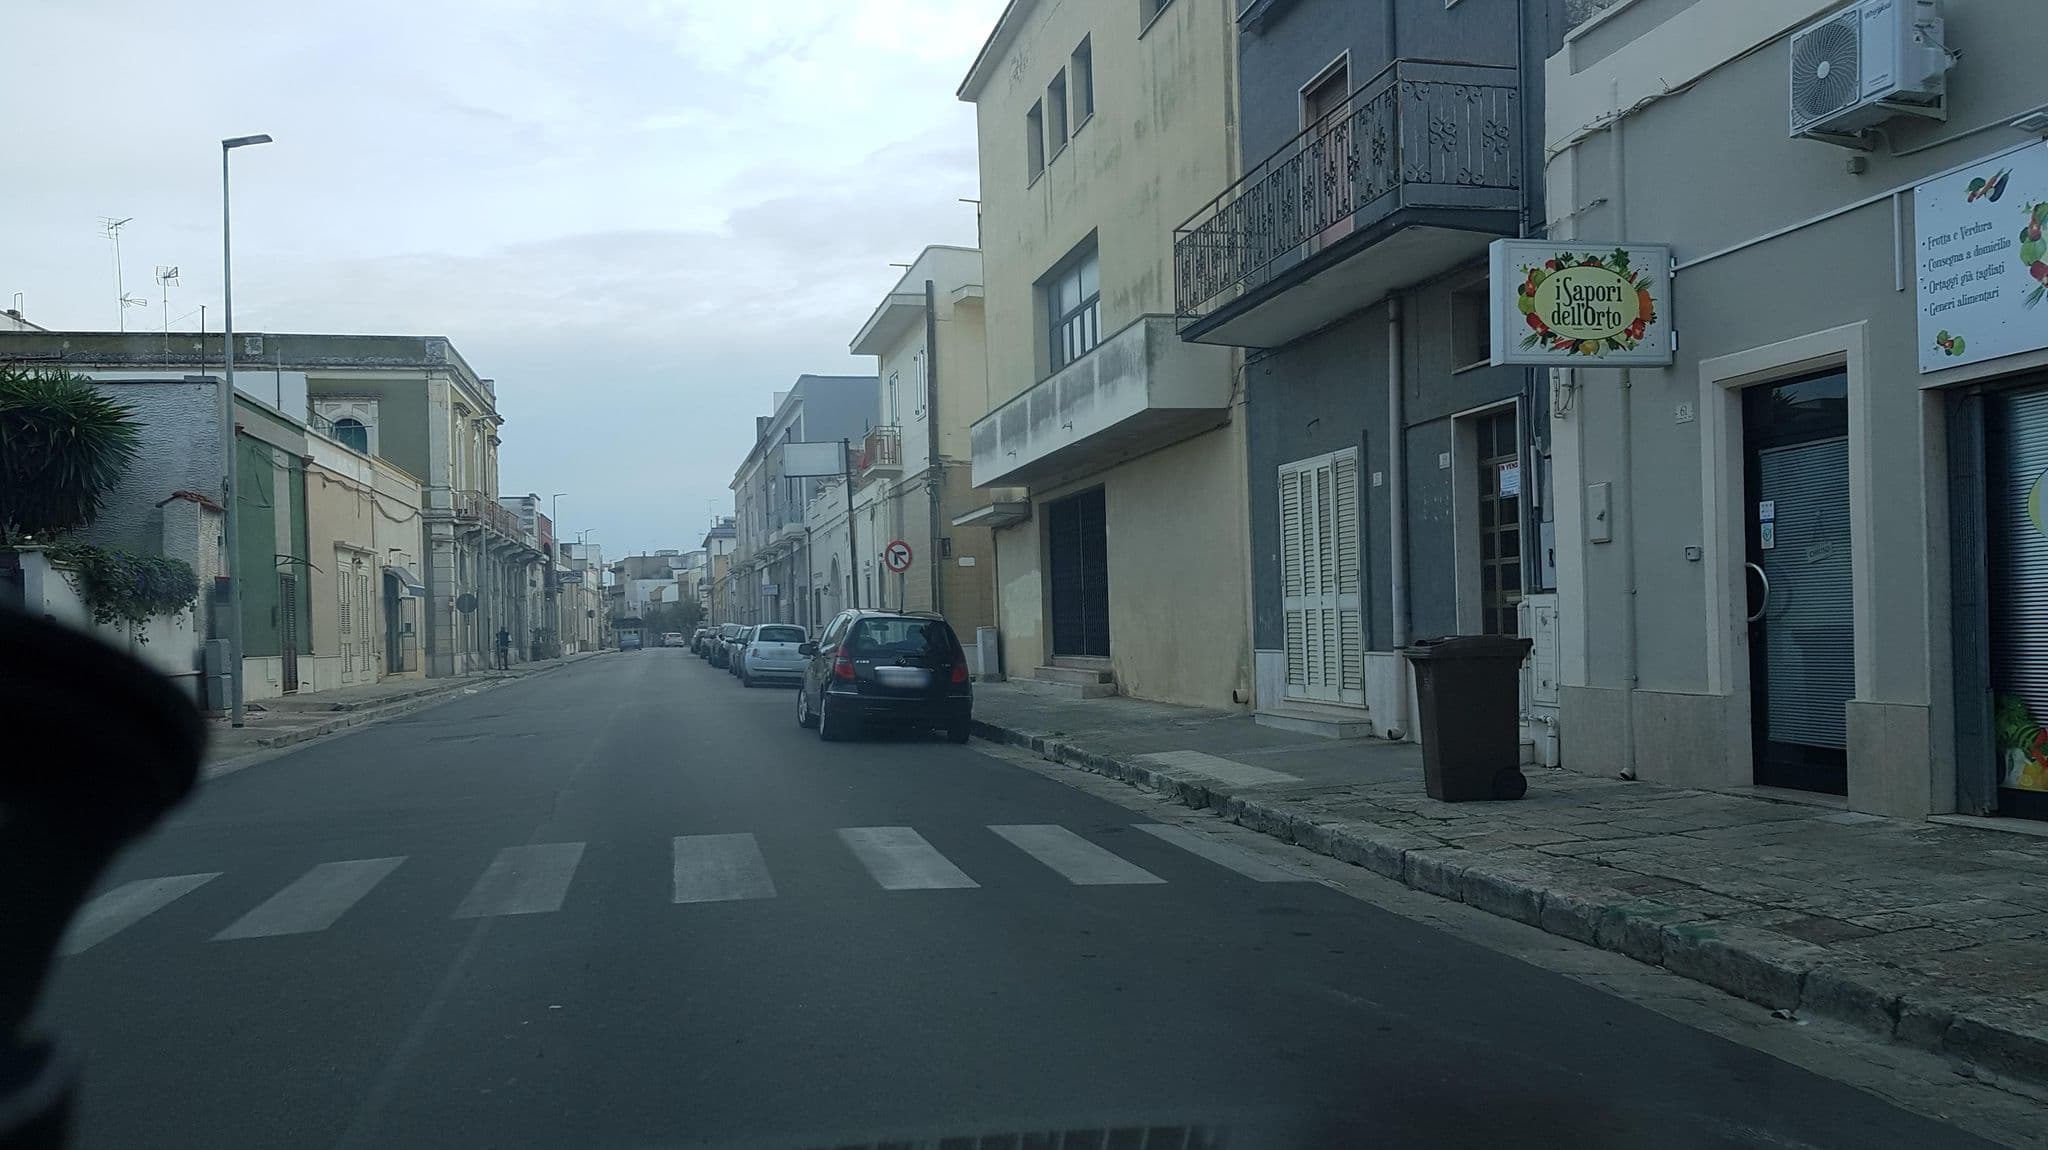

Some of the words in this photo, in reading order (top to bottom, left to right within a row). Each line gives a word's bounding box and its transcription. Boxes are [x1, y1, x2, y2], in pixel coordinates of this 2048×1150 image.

[1927, 235, 1952, 250] Frutta
[1953, 232, 1959, 240] e
[1960, 221, 1993, 240] Verdura
[1928, 253, 1964, 272] Consegna
[1966, 251, 1972, 259] a
[1973, 237, 2011, 257] domicilio
[1555, 278, 1561, 301] i
[1563, 277, 1623, 309] Sapori
[1928, 273, 1959, 294] Ortaggi
[1975, 261, 2005, 281] tagliati
[1551, 302, 1622, 329] dell'Orto
[1929, 297, 1955, 316] Generi
[1957, 286, 1999, 307] alimentari
